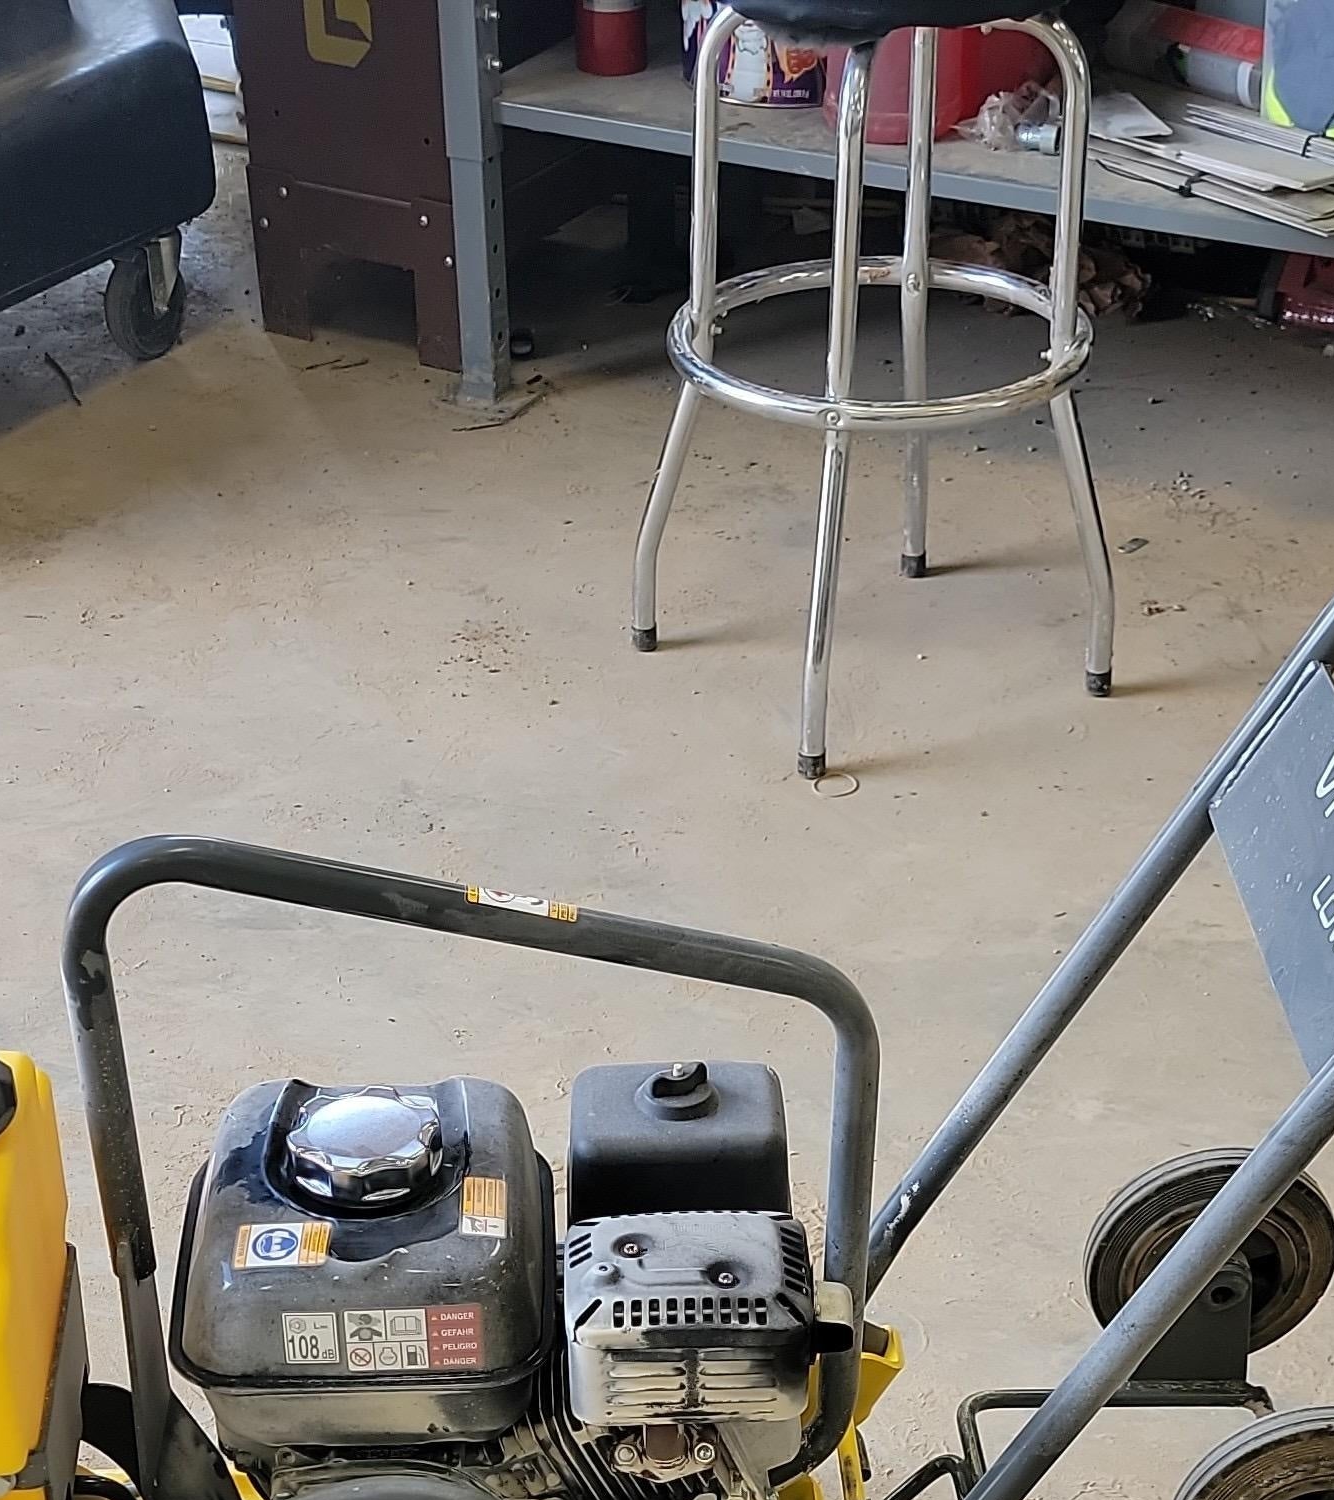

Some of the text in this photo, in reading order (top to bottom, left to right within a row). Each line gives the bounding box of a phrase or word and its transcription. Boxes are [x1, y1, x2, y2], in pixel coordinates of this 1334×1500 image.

[440, 1312, 474, 1321] DANGER
[441, 1328, 474, 1337] GEFAHR
[288, 1335, 320, 1360] 108
[442, 1342, 477, 1350] PELIGRO
[322, 1349, 335, 1360] dB
[443, 1357, 477, 1366] DANGER
